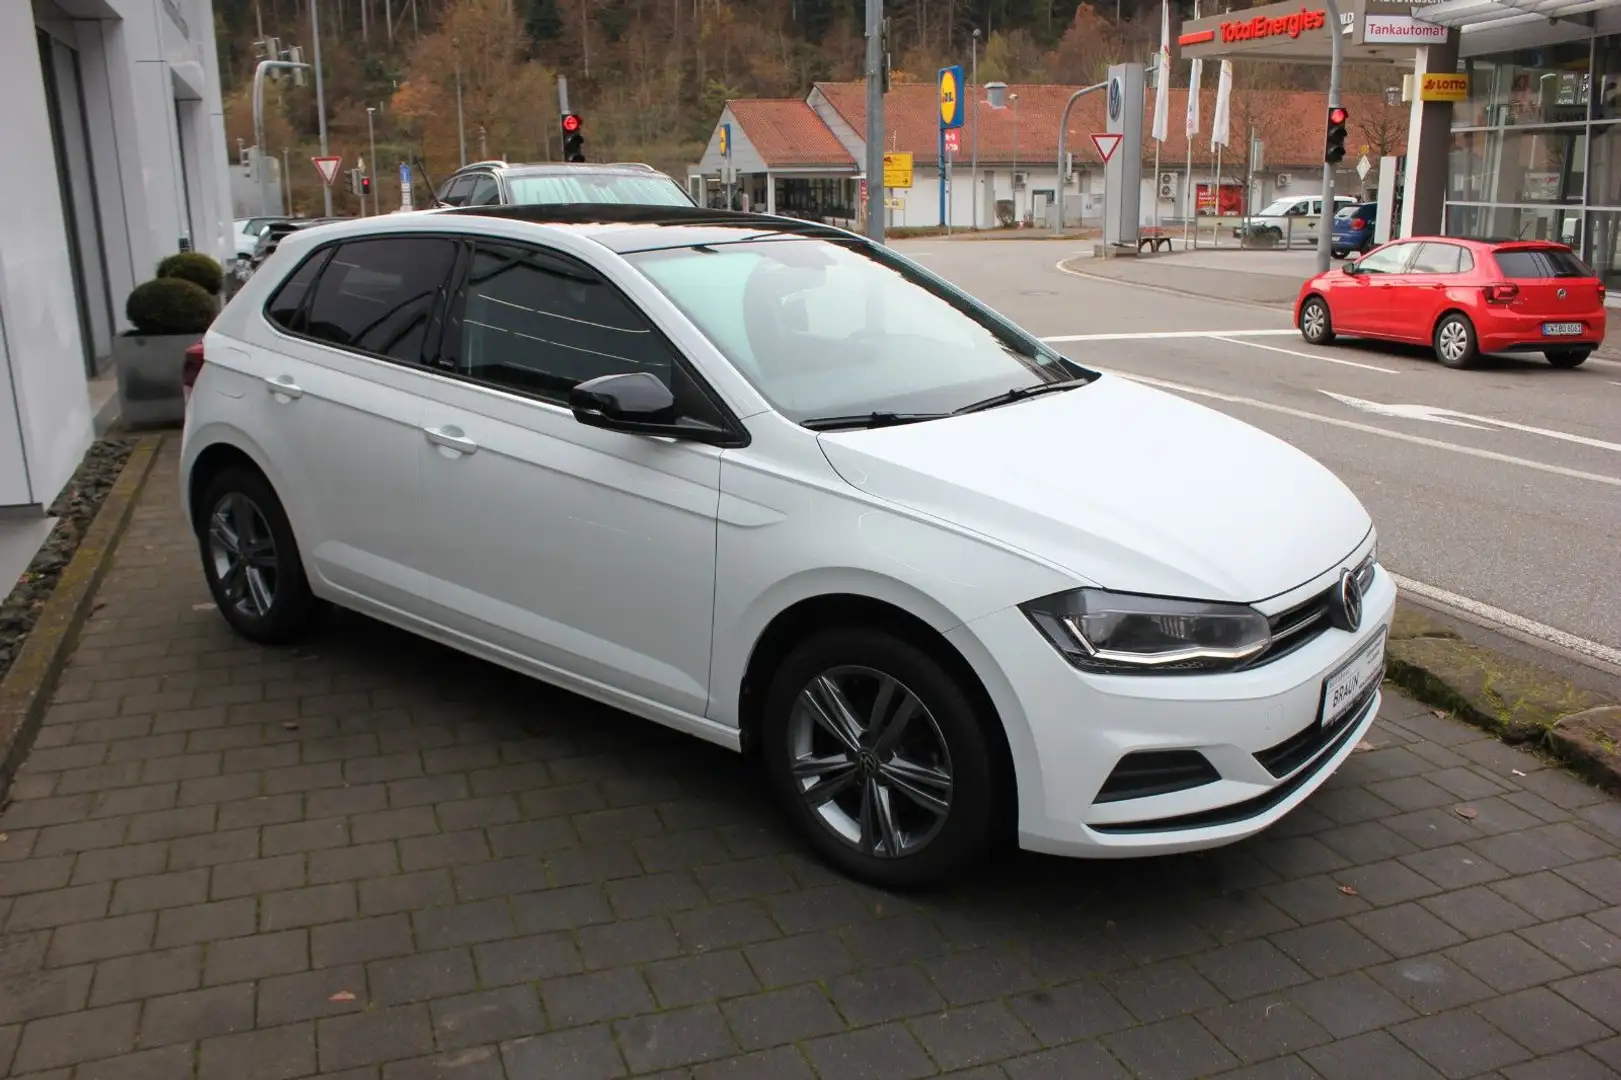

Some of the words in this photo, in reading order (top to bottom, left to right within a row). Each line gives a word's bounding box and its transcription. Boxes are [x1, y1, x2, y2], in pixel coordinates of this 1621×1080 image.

[1220, 8, 1326, 43] TotalEnergies
[1369, 23, 1445, 36] Tankautomat
[1436, 79, 1467, 90] LOTTO
[1332, 671, 1360, 708] BRAUN
